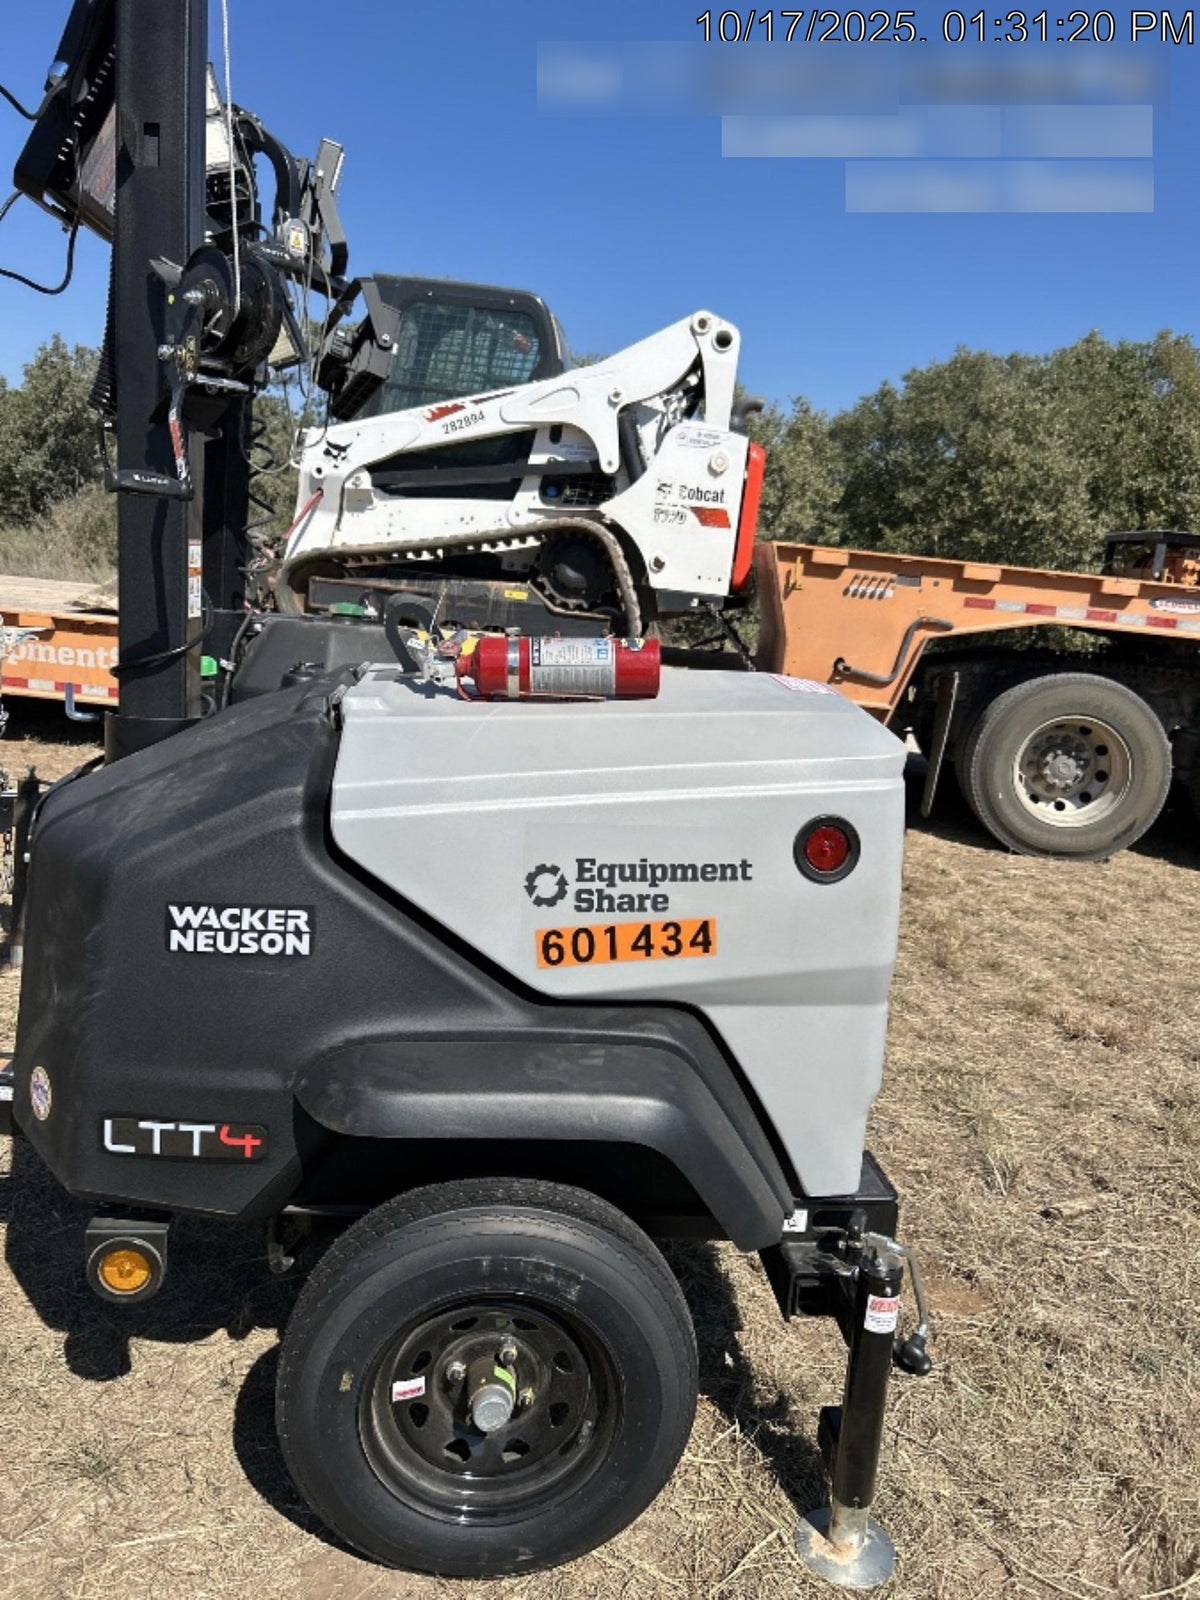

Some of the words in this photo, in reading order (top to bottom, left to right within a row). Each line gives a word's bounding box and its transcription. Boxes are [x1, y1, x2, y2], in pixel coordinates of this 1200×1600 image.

[679, 484, 725, 504] Bobcat
[575, 858, 753, 887] Equipment
[574, 888, 669, 913] Share
[168, 904, 312, 932] WACKER
[169, 929, 311, 956] NEUSON
[541, 920, 712, 966] 601434
[104, 1119, 262, 1158] LTT4
